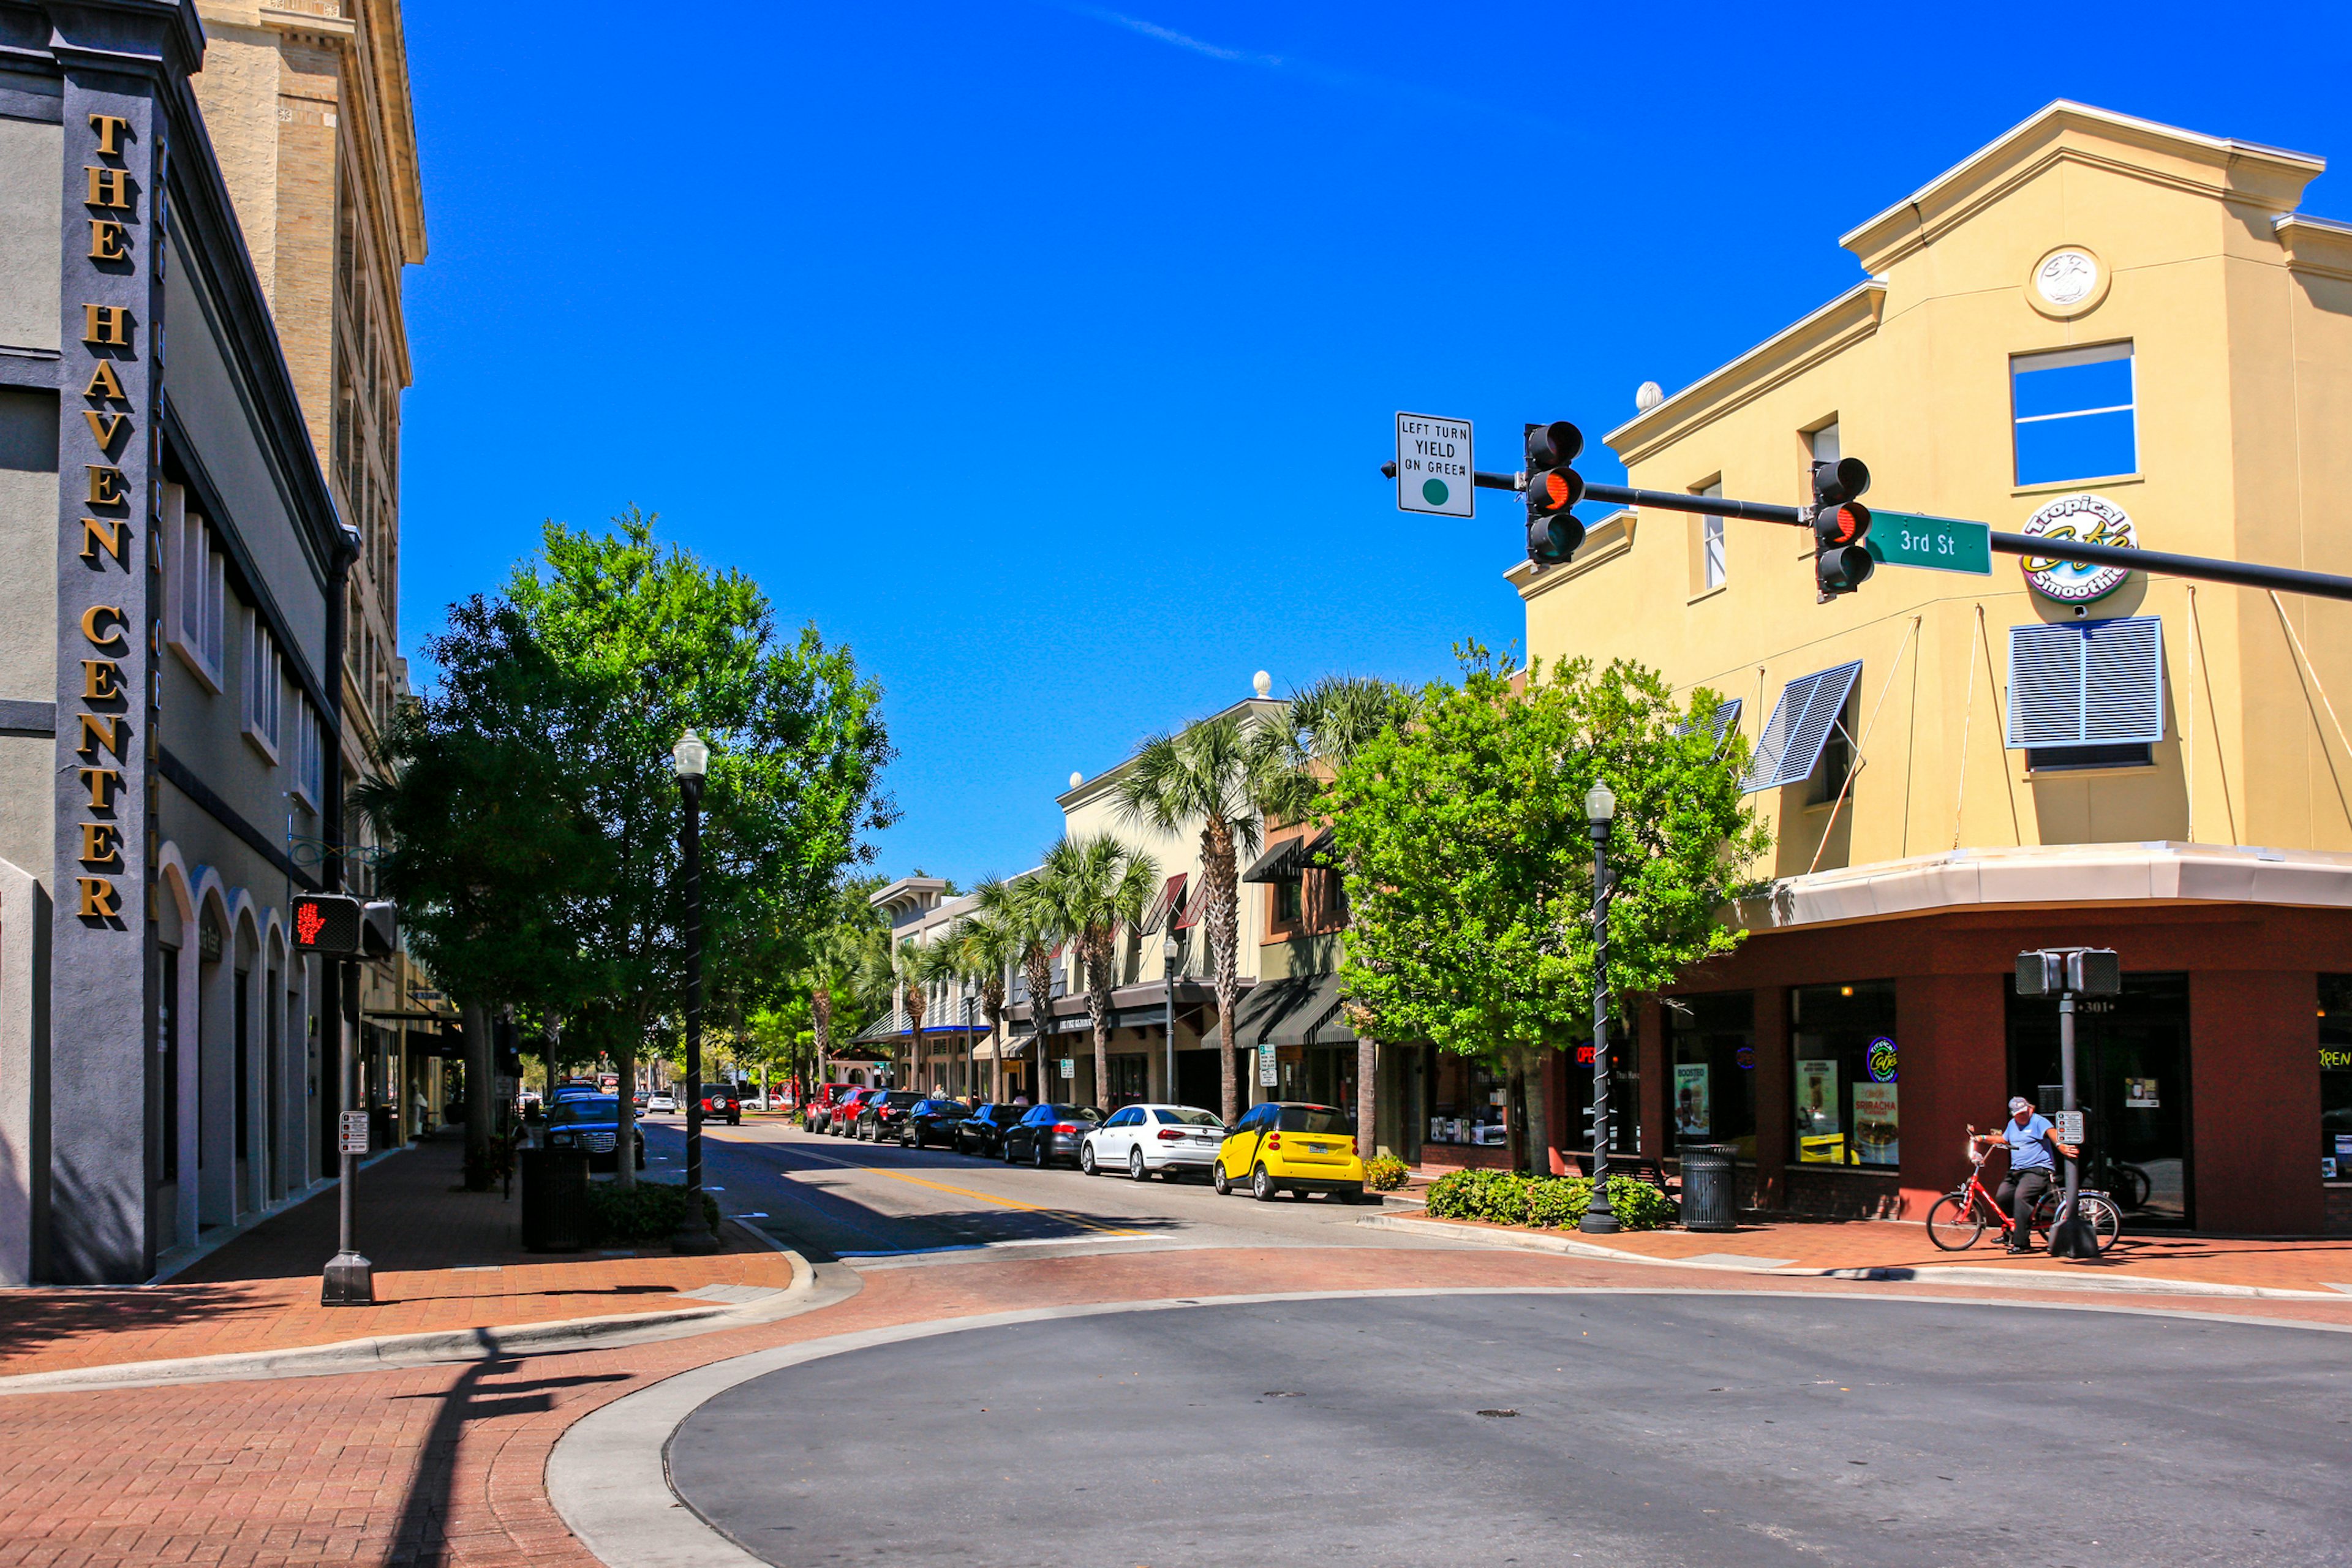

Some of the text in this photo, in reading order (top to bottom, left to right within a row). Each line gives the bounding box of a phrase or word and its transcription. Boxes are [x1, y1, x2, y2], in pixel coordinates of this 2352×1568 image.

[1402, 421, 1466, 440] LEFT TURN
[1415, 439, 1455, 458] YIELD
[1404, 459, 1466, 476] ON GREEN
[76, 113, 130, 918] THE HAVEN CENTER
[2025, 496, 2125, 534] Tropical
[1901, 530, 1954, 556] 3rd St
[2031, 567, 2125, 598] Smoothie
[2084, 1001, 2108, 1013] 301
[1577, 1046, 1597, 1063] OPE
[1870, 1040, 1895, 1053] Tropical
[1870, 1052, 1898, 1070] Café
[1678, 1068, 1704, 1077] BOOSTED
[1855, 1101, 1896, 1110] SRIRACHA
